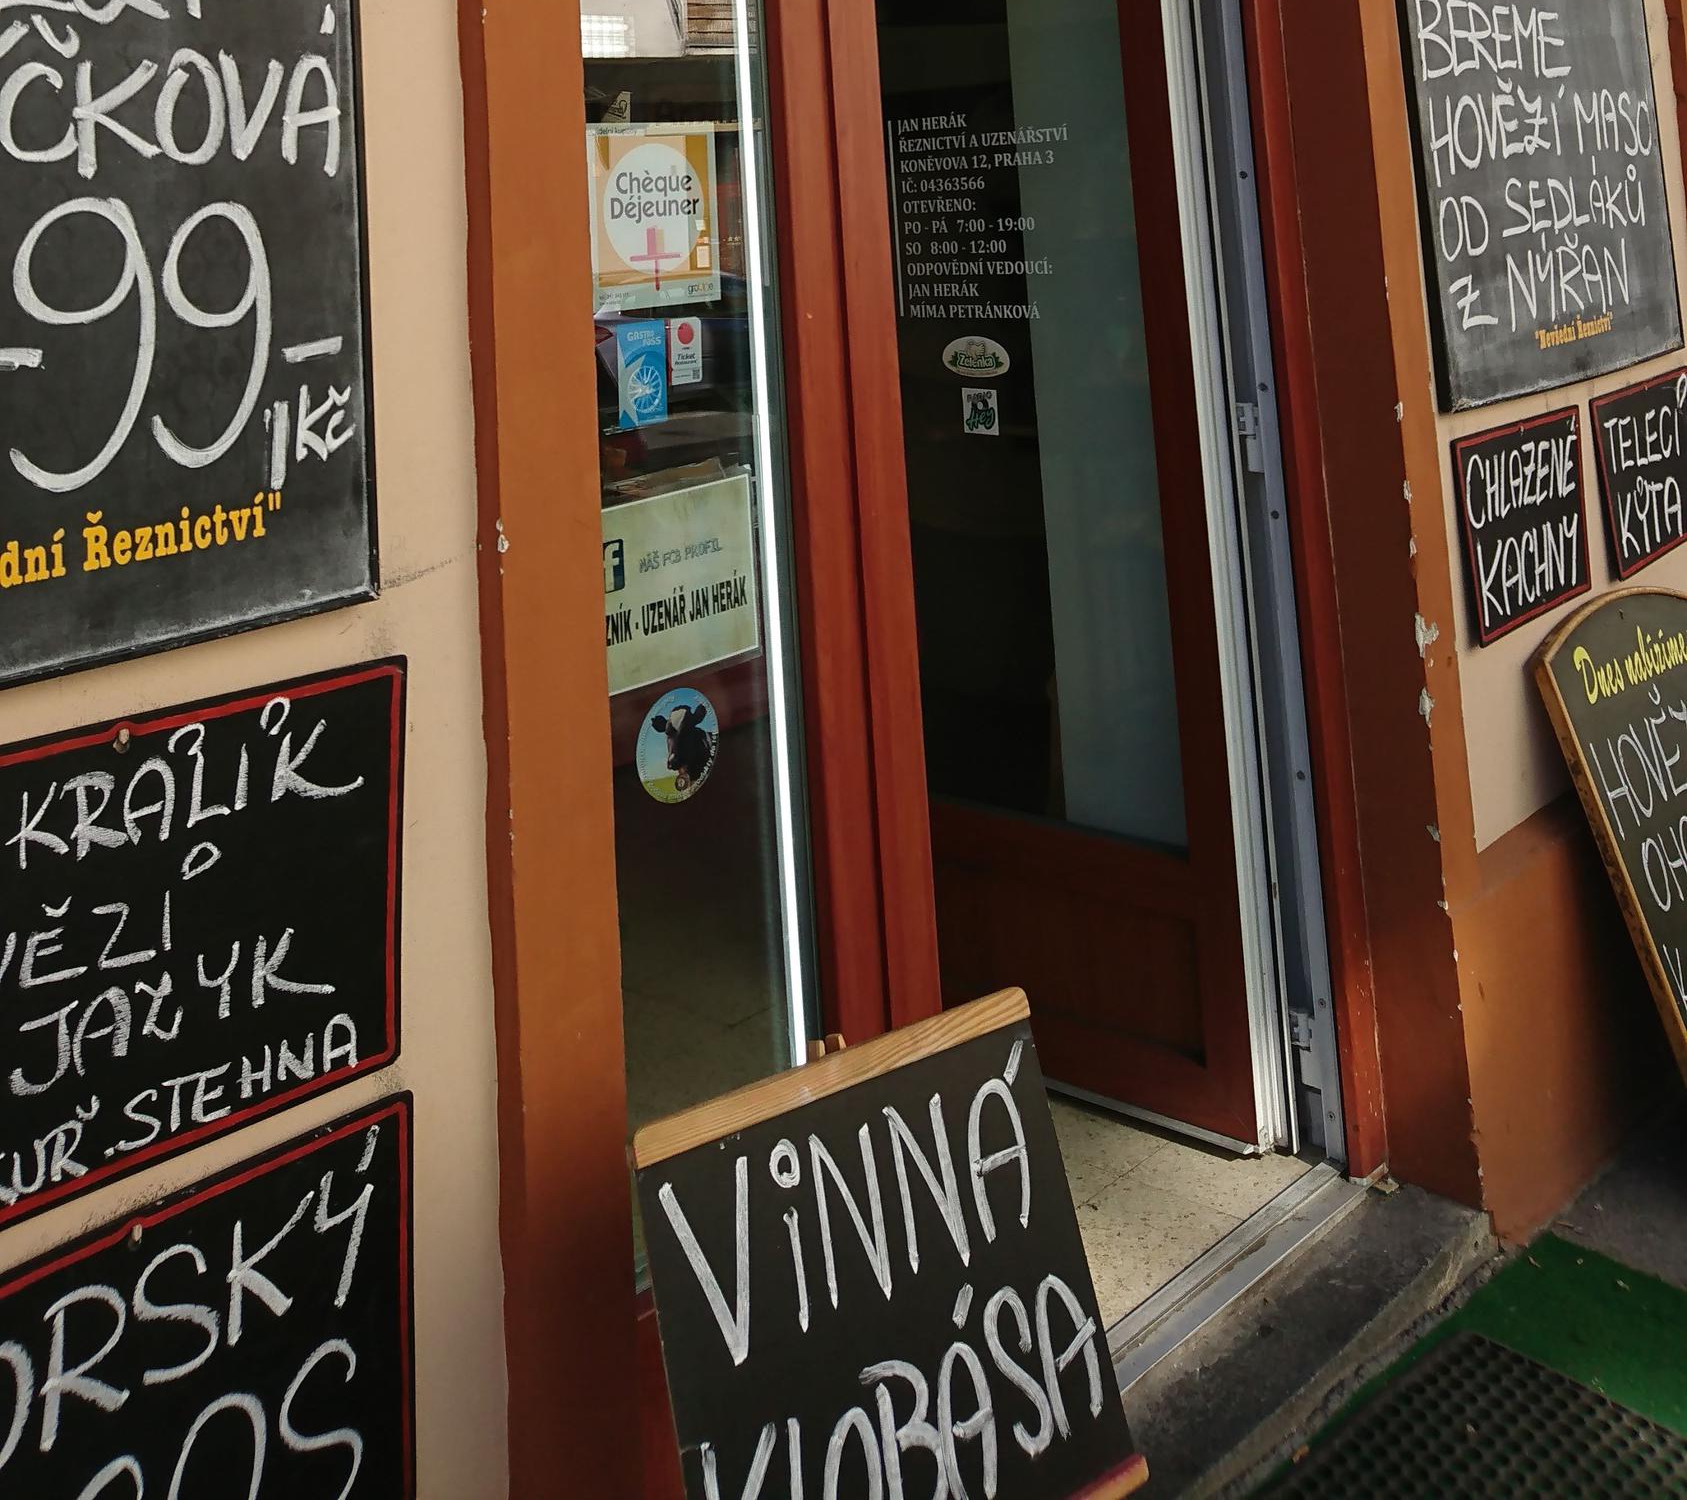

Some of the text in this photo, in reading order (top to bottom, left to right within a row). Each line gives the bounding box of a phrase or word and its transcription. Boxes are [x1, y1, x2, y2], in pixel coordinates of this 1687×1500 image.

[897, 111, 967, 135] JAN HERÁK
[1430, 75, 1652, 188] HOVĚZÍ MASO
[899, 123, 1069, 153] ŘEZNICTVÍ A UZENÁŘSTVÍ
[900, 150, 1055, 173] KONĚVOVA 12, PRAHA 3
[616, 170, 692, 197] Chèque
[901, 176, 985, 194] IČ: 04363566
[610, 195, 699, 224] Déjeuner
[903, 196, 977, 214] OTEVŘENO:
[1439, 155, 1646, 262] OD SEDLÁKŮ
[904, 221, 921, 235] PO
[932, 217, 948, 234] PÁ
[957, 219, 986, 233] 7:00
[997, 217, 1035, 232] 19:00
[906, 242, 922, 256] SO
[930, 240, 959, 254] 8:00
[970, 239, 1007, 254] 12:00
[906, 257, 1053, 276] ODPOVĚDNÍ VEDOUCÍ:
[908, 280, 979, 300] JAN HERÁK
[1506, 231, 1631, 333] NÝŘAN
[910, 301, 1041, 319] MÍMA PETRÁNKOVÁ
[1617, 476, 1685, 558] KÝTA
[82, 491, 282, 573] Řeznictví"
[1477, 513, 1578, 628] KACHNY
[642, 585, 687, 636] UZENÁŘ
[689, 586, 709, 622] JAN
[712, 569, 747, 615] HERÁK
[1573, 646, 1625, 705] Dnes
[5, 696, 365, 870] KRÁLÍK
[116, 1012, 359, 1151] STEHNA
